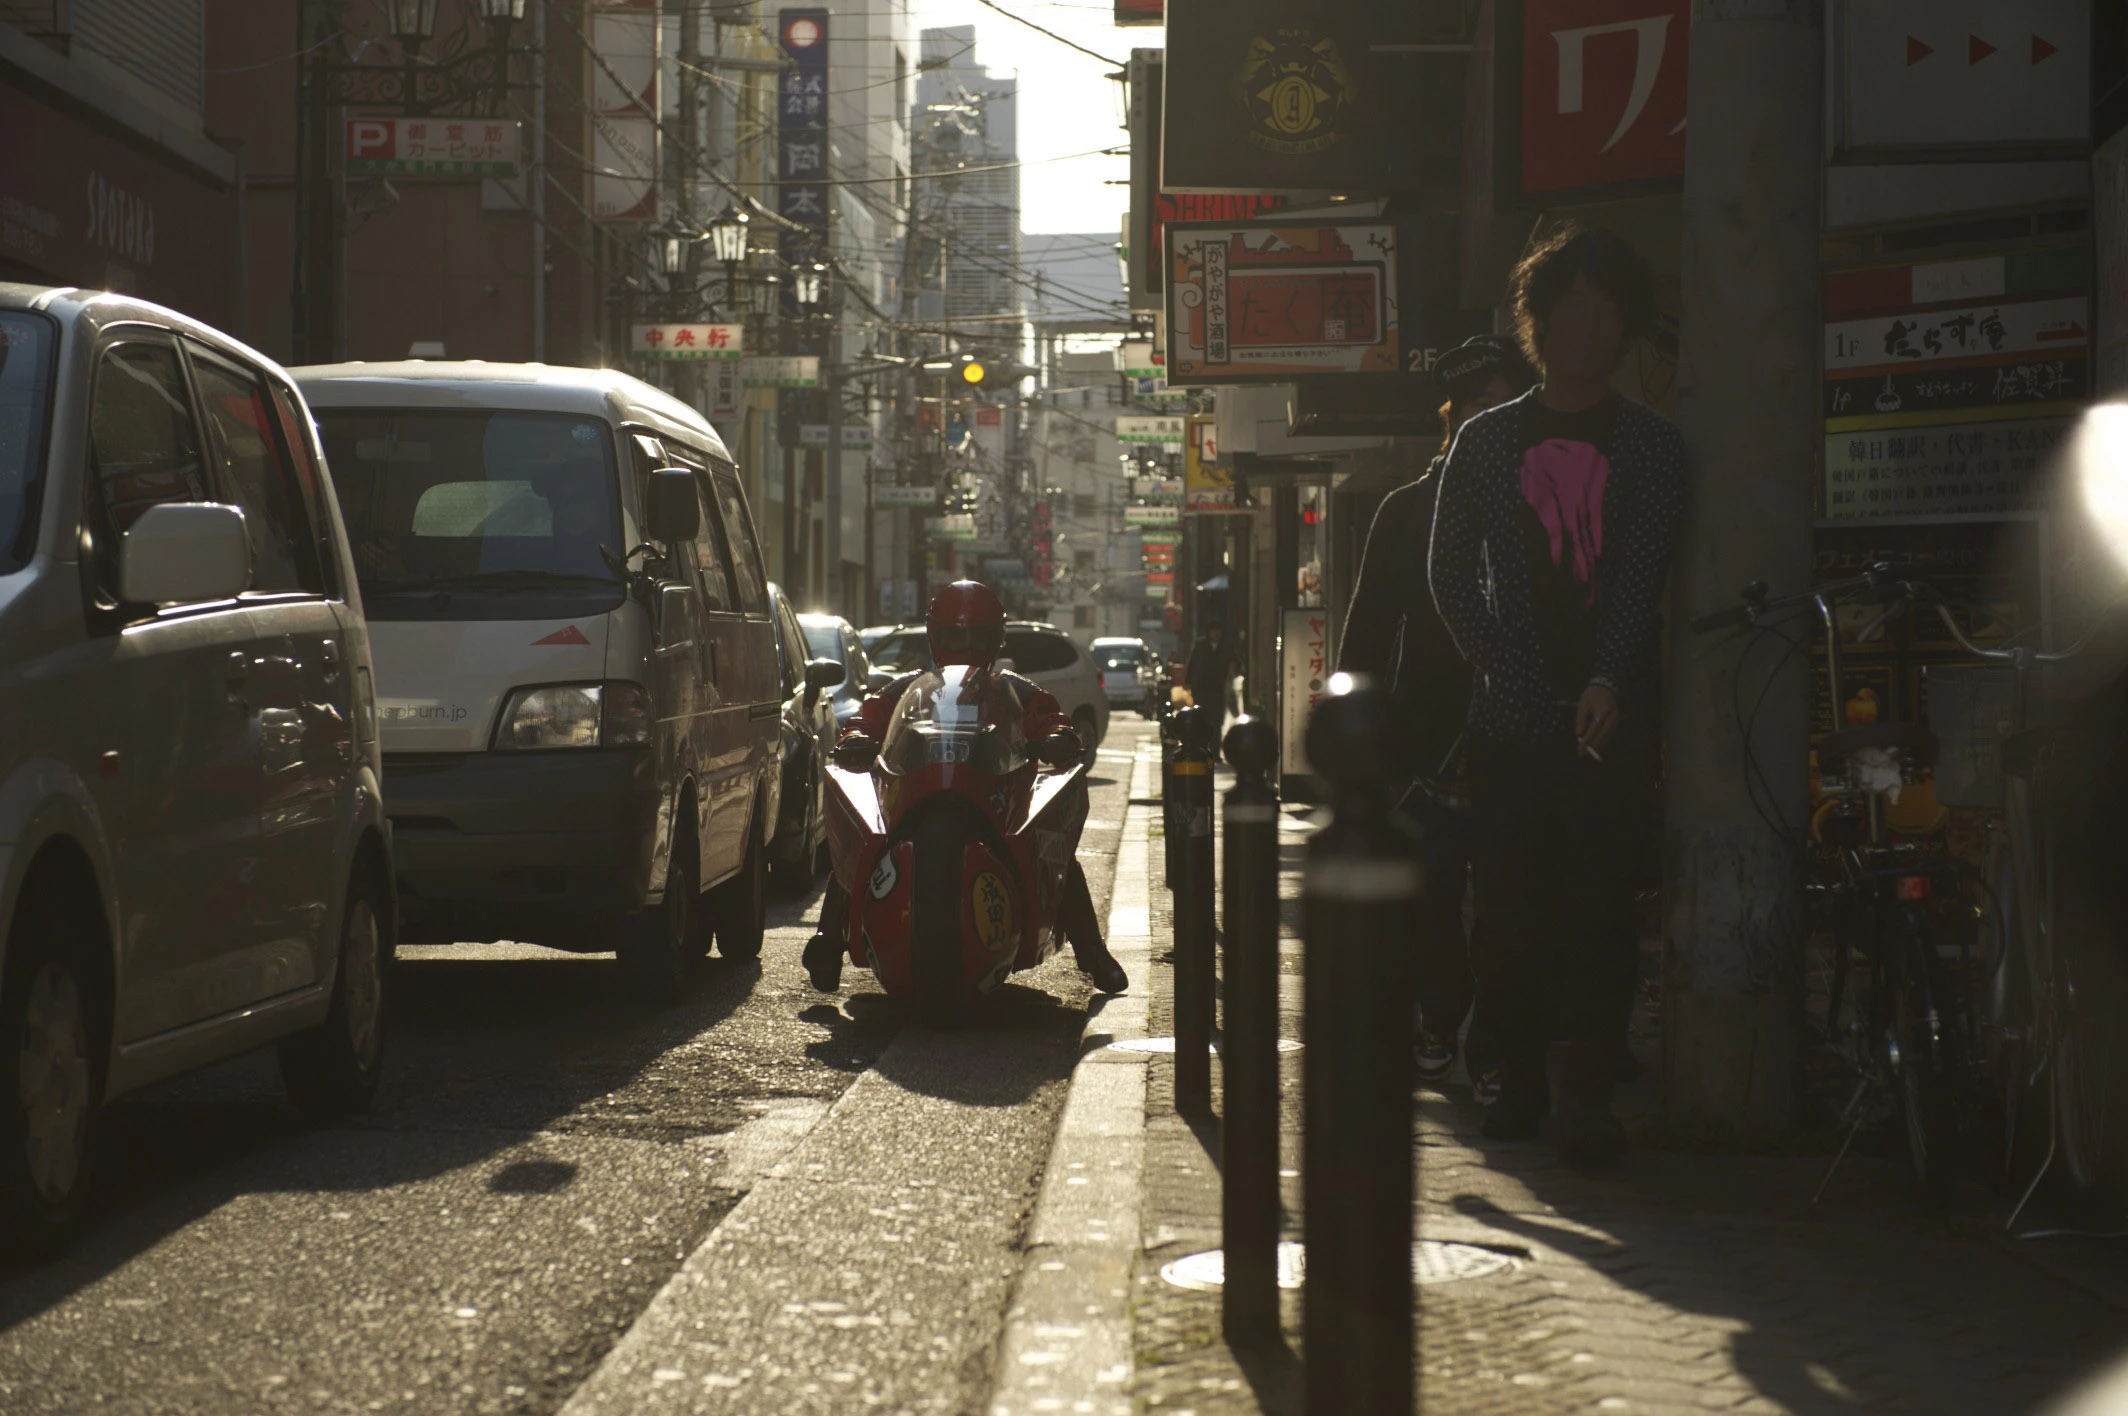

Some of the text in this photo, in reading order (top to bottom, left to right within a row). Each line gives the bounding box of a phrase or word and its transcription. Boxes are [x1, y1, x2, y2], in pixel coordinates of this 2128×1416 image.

[1550, 13, 1688, 154] ワ
[1207, 245, 1226, 361] がやがや酒場
[1408, 348, 1438, 373] 2F
